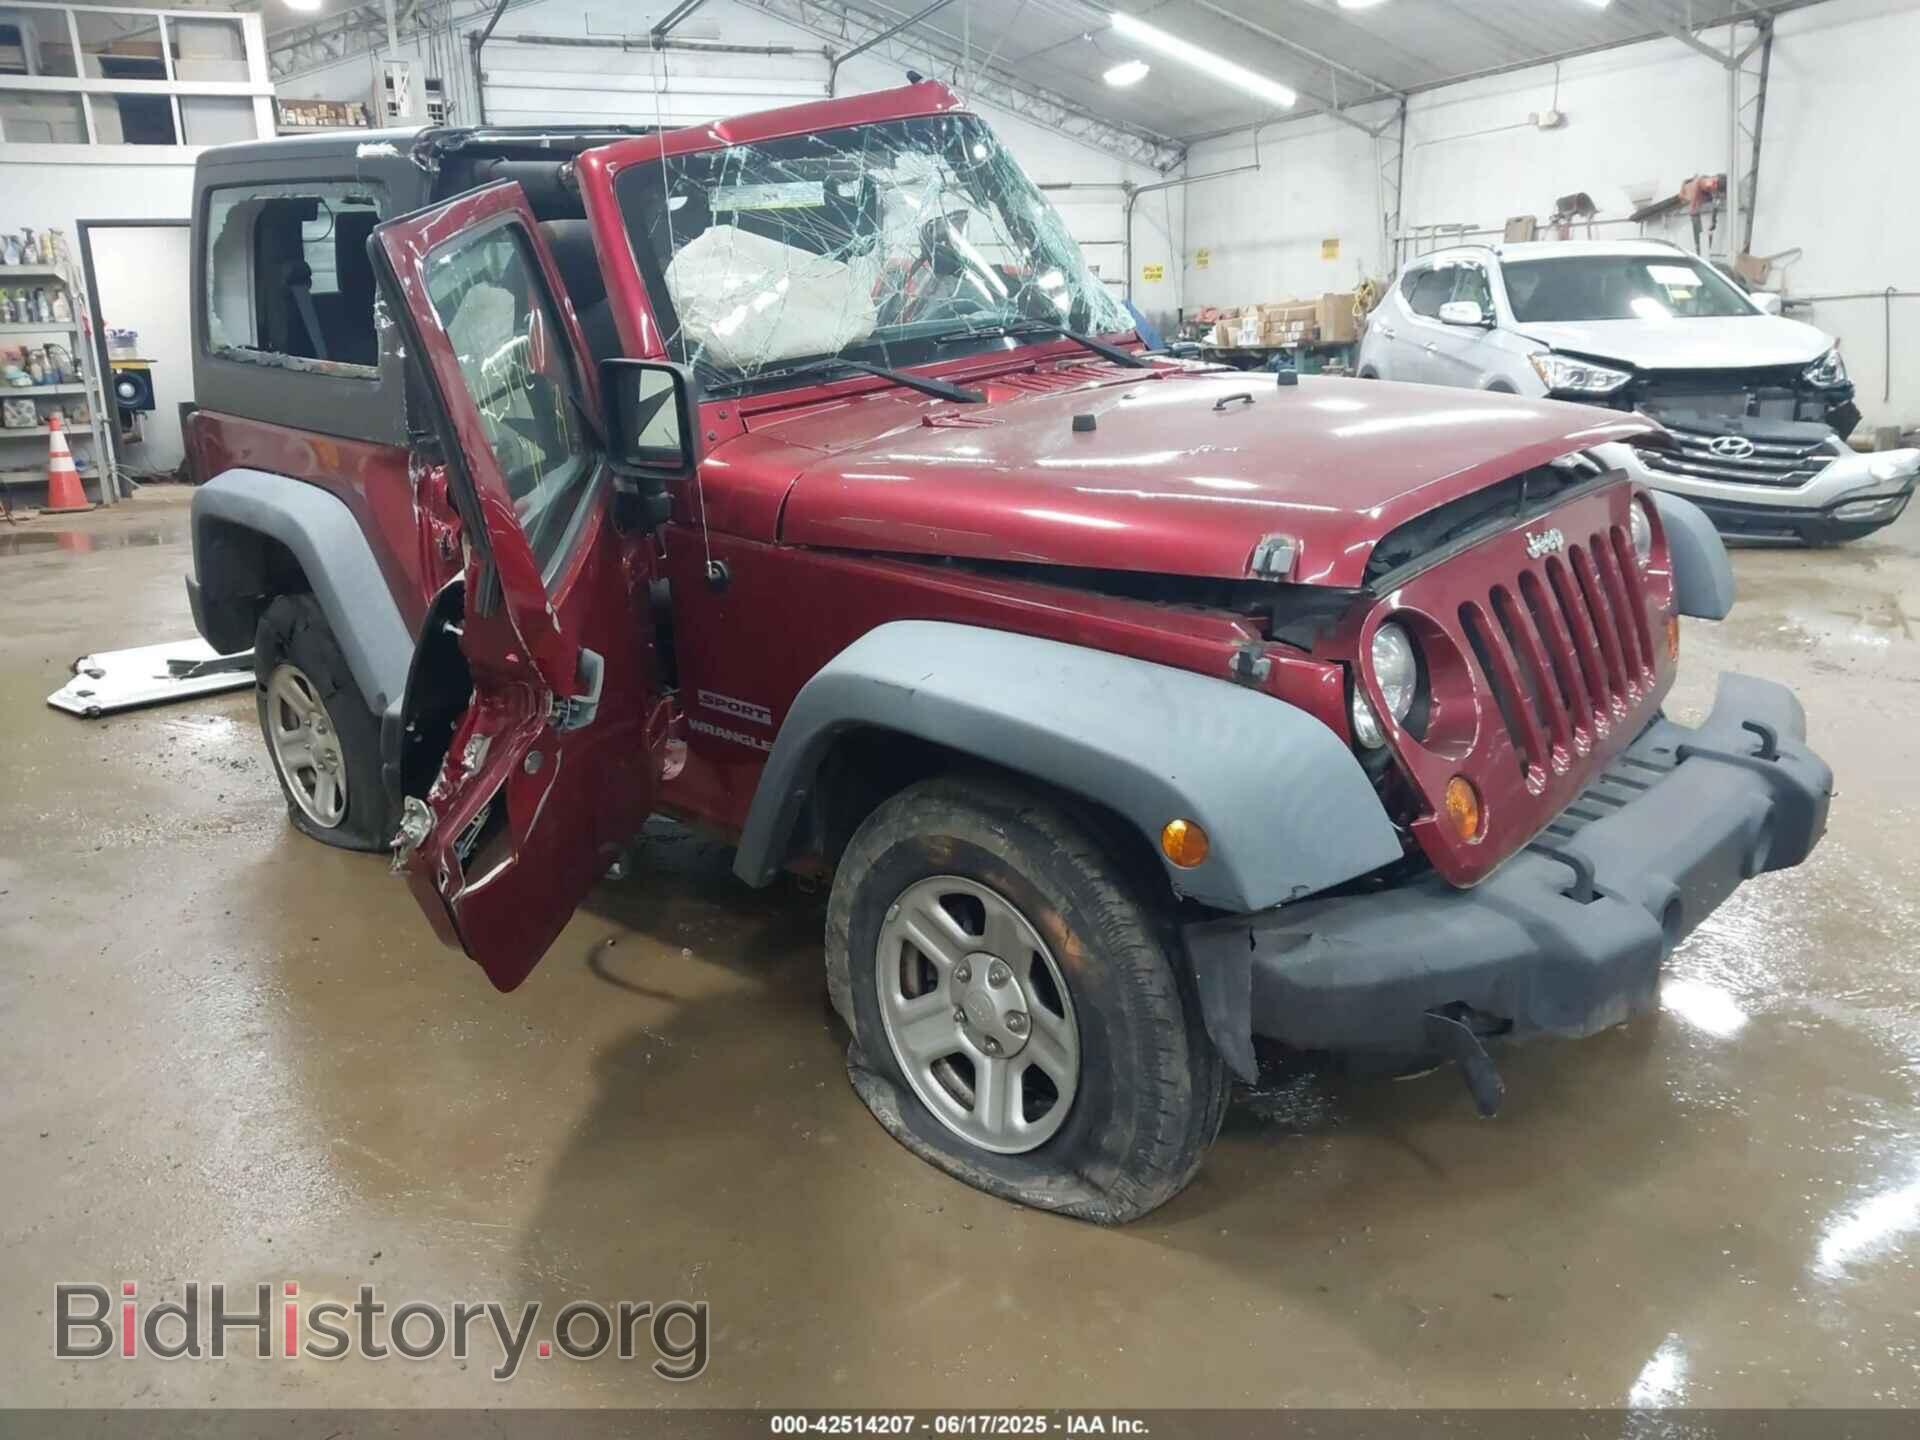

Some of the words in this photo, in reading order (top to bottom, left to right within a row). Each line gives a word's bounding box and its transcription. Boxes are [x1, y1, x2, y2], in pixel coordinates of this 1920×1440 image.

[1526, 529, 1564, 558] Jeep
[701, 693, 771, 719] SPORT
[688, 719, 776, 752] WRANGLE
